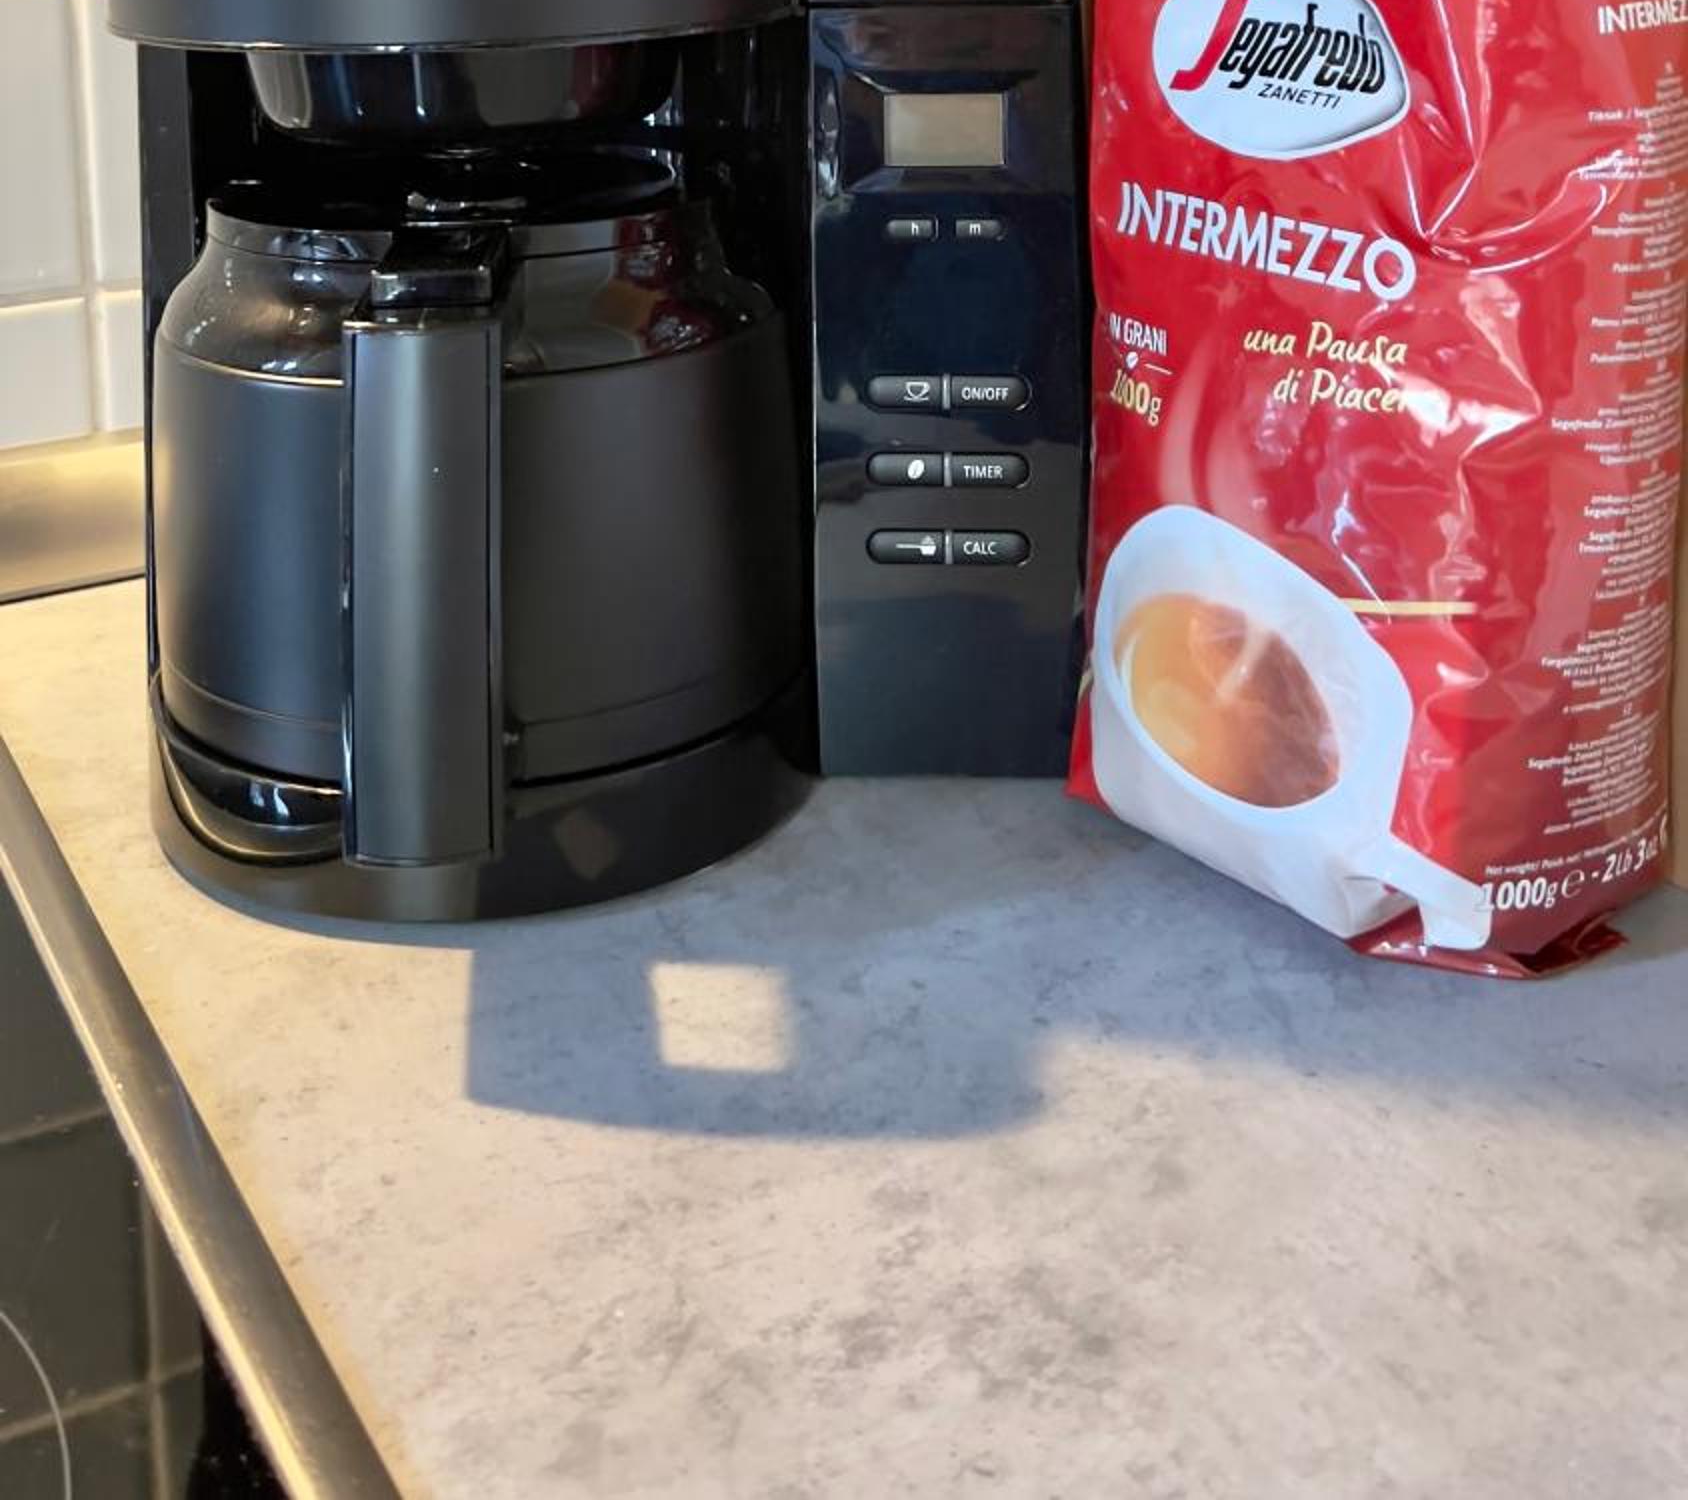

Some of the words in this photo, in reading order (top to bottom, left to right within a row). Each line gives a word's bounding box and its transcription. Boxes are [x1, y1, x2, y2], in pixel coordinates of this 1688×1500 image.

[1258, 83, 1342, 110] ZANETTI
[911, 222, 919, 235] h
[969, 223, 981, 235] m
[1116, 181, 1417, 301] INTERMEZZO
[1123, 318, 1167, 357] GRANI
[1243, 329, 1297, 357] una
[1306, 321, 1408, 368] Pausa
[961, 386, 1009, 401] ON/OFF
[1273, 367, 1304, 404] di
[963, 465, 1003, 479] TIMER
[963, 541, 998, 555] CALC
[1478, 876, 1559, 911] 1000g
